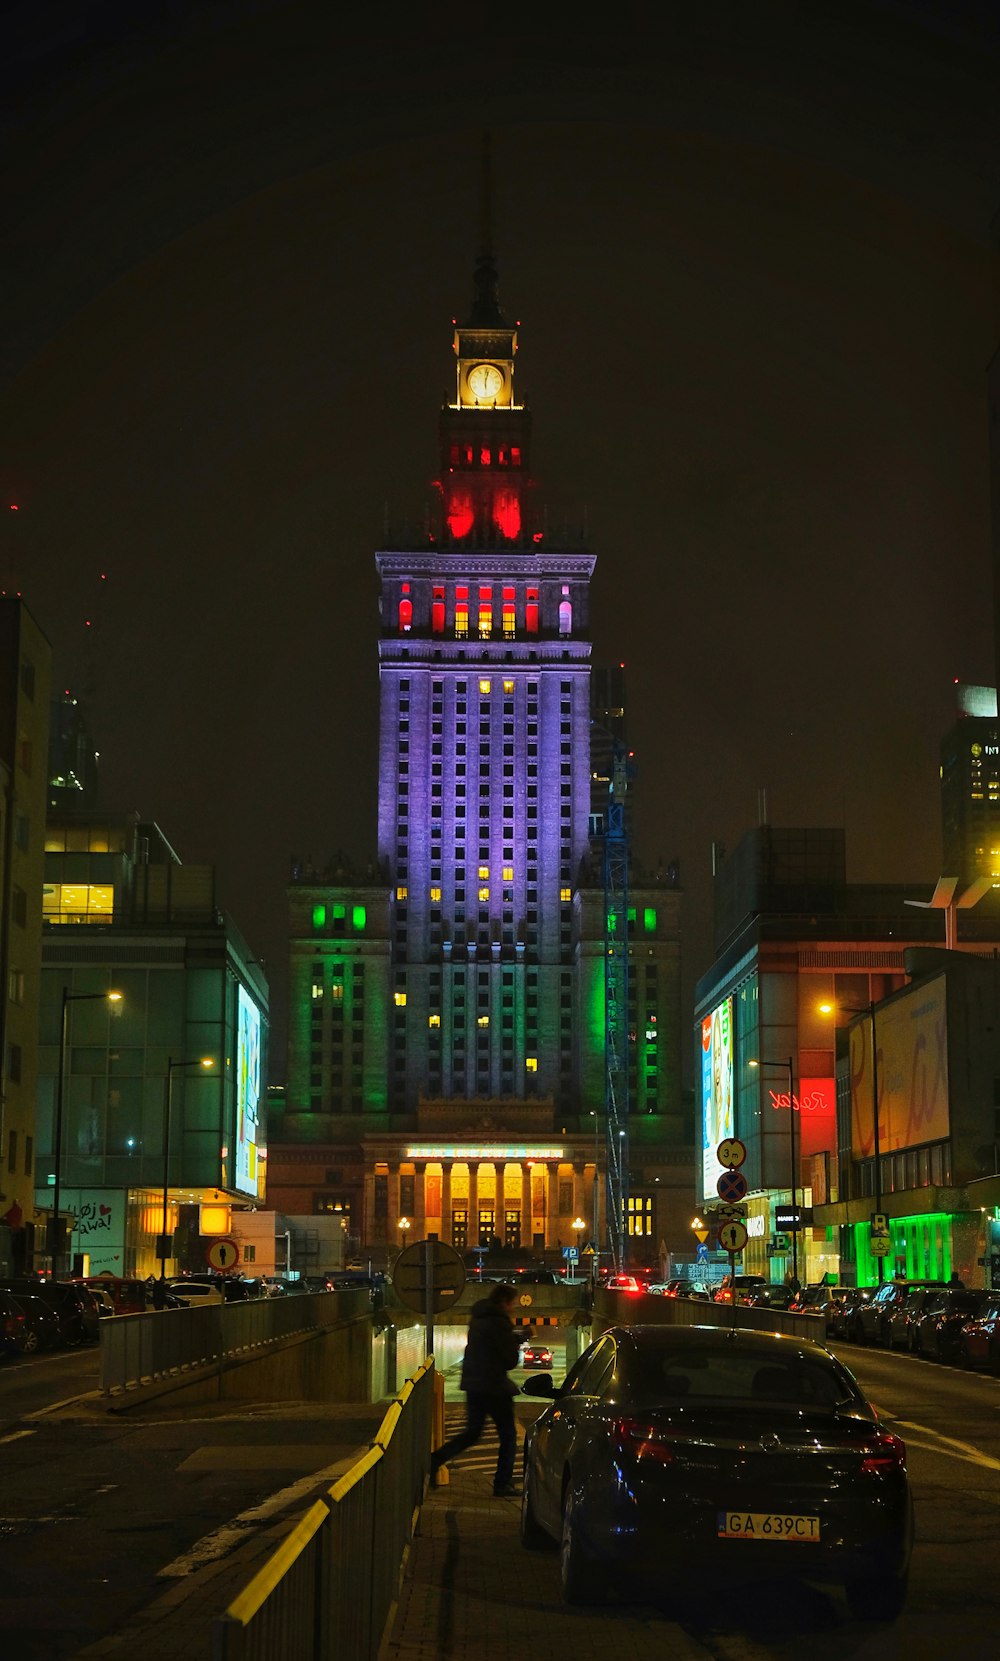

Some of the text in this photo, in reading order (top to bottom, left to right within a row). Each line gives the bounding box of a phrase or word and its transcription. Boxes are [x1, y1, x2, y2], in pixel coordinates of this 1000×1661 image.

[723, 1148, 730, 1158] 3
[776, 1236, 786, 1249] P
[569, 1248, 577, 1258] P
[729, 1514, 817, 1536] GA 639CT
